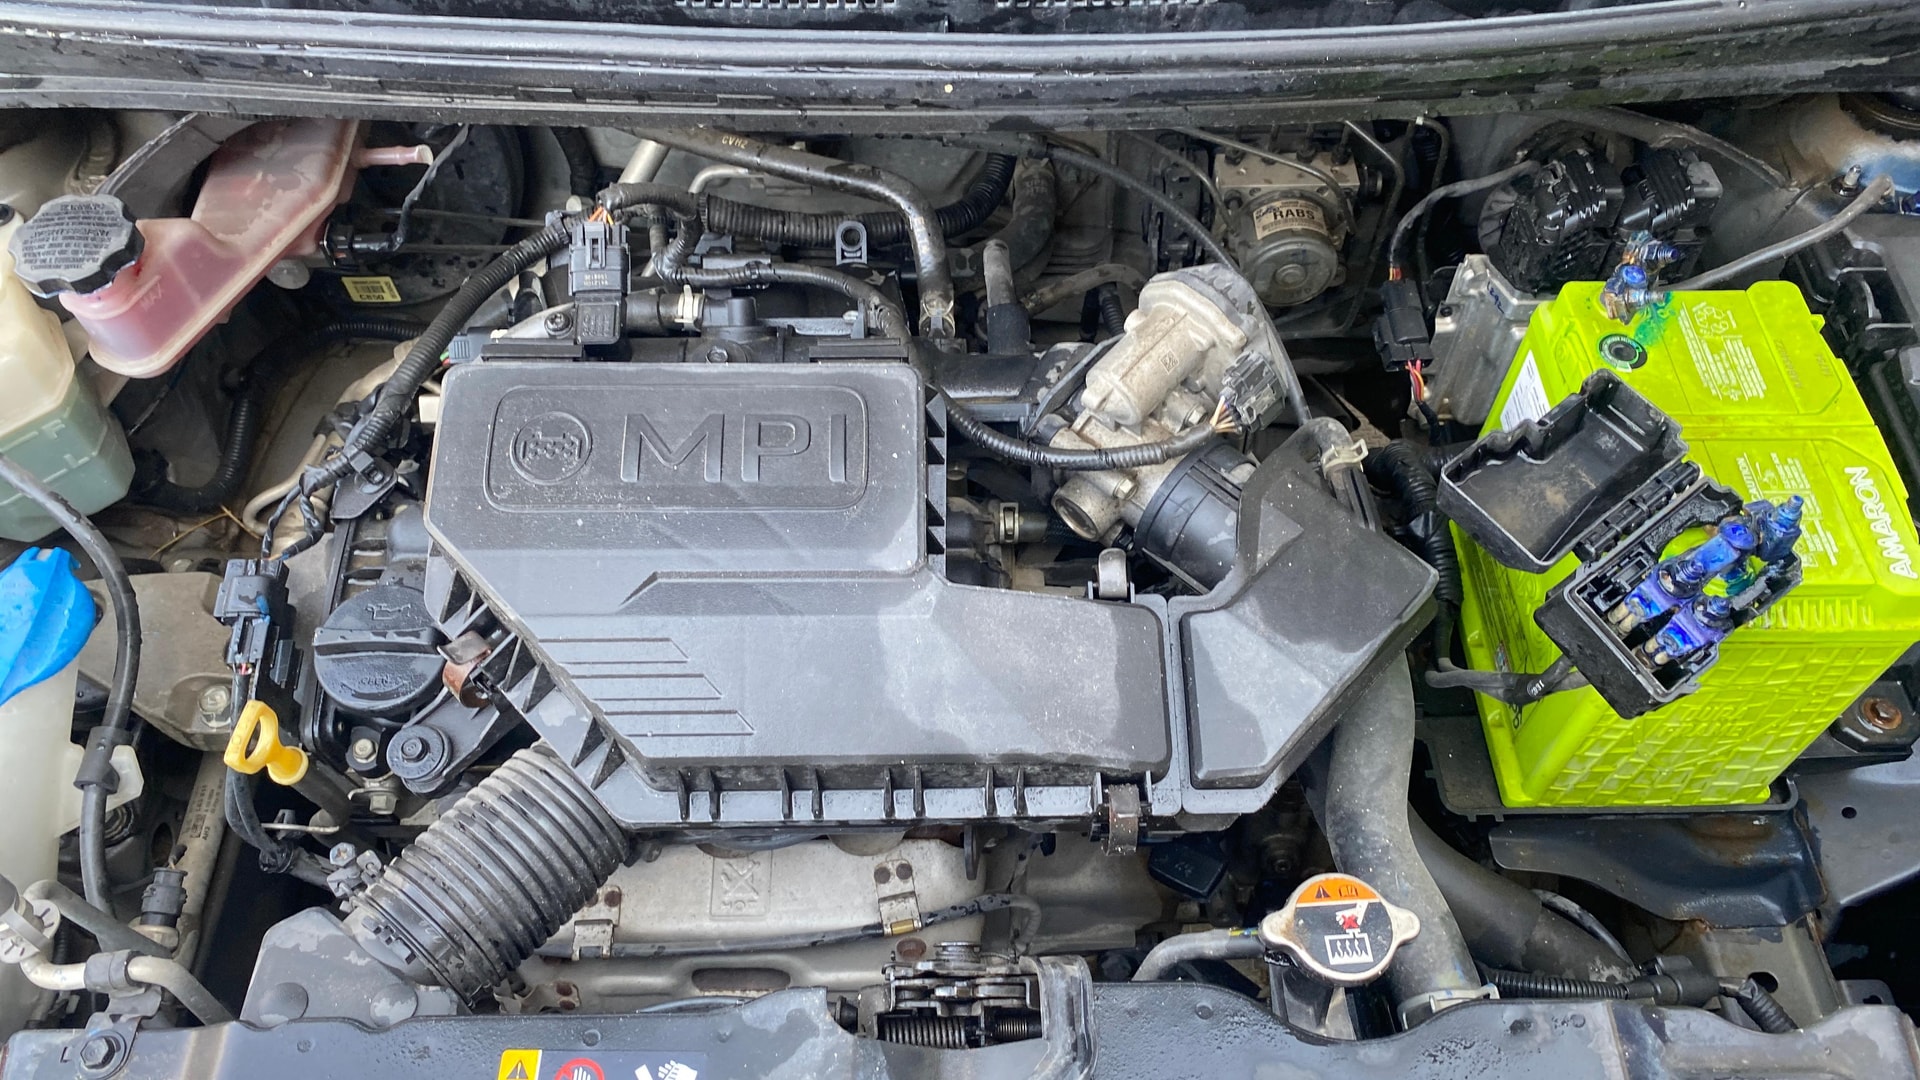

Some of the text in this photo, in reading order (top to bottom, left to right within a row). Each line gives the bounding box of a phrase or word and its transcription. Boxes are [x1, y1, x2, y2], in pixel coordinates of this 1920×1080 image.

[620, 413, 848, 483] MPI
[1736, 456, 1764, 502] CAUTION
[1844, 466, 1919, 580] AMARON
